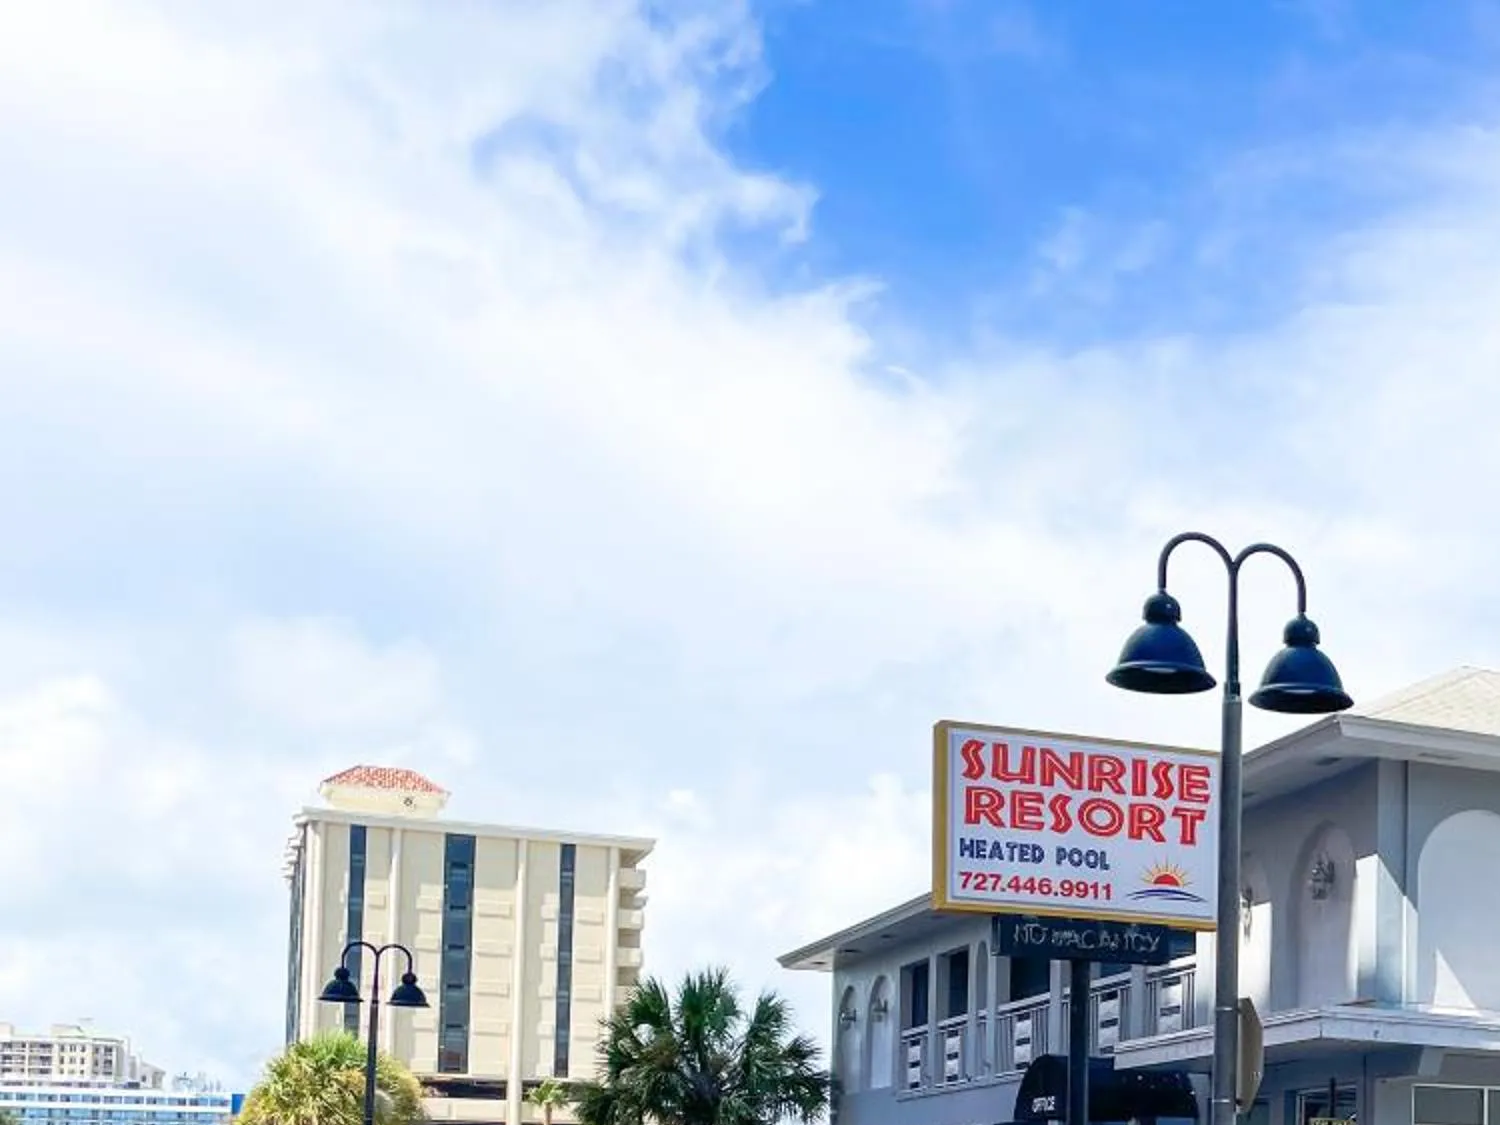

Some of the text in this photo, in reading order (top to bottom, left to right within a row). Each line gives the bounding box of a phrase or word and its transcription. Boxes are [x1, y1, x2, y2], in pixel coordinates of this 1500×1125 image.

[960, 739, 1211, 804] SUNRISE
[964, 786, 1206, 846] RESORT
[959, 837, 1110, 871] HEATED POOL
[959, 870, 1112, 900] 727.446.9911
